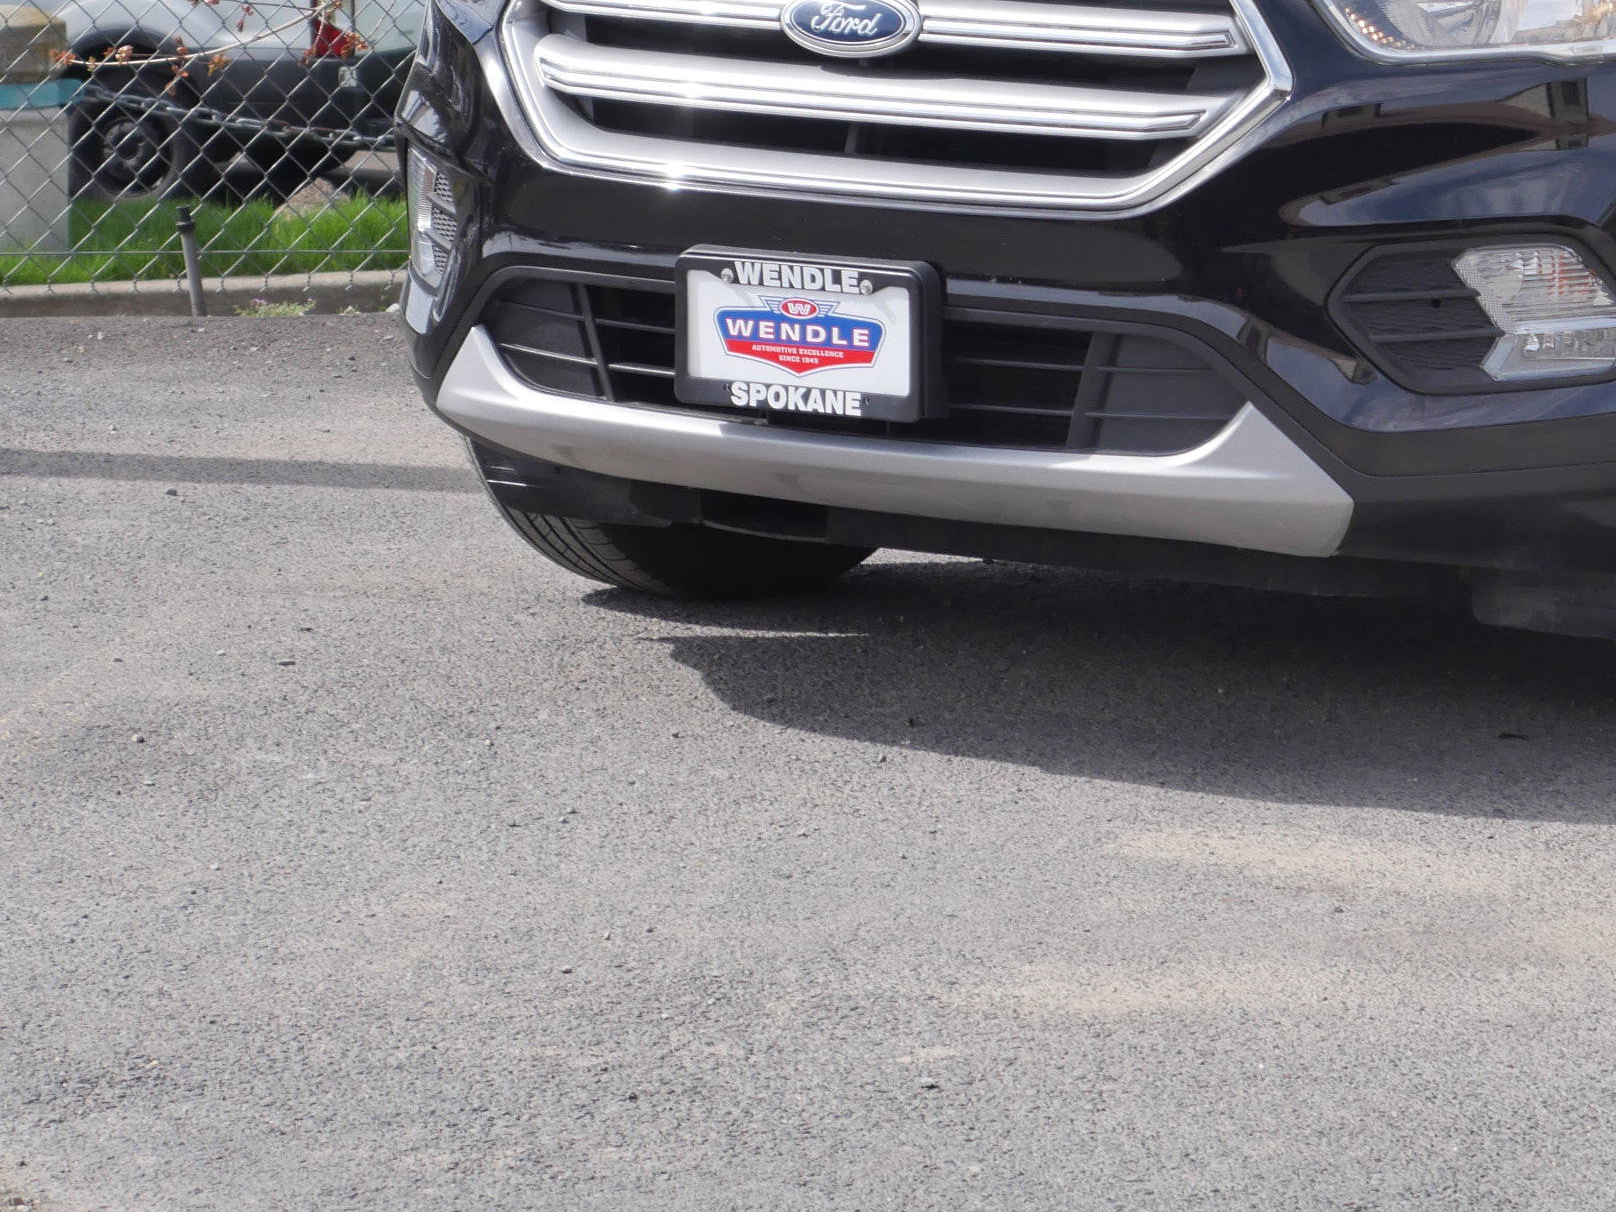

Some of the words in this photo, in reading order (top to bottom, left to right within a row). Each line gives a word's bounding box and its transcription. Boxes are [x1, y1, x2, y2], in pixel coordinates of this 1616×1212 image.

[811, 0, 882, 36] Ford
[734, 261, 861, 294] WENDLE
[786, 302, 812, 316] W
[726, 318, 870, 347] WENDLE
[751, 344, 797, 355] AUTOMOTIVE
[798, 347, 844, 358] EXCELLENCE
[778, 354, 801, 363] SINCE
[730, 381, 862, 417] SPOKANE
